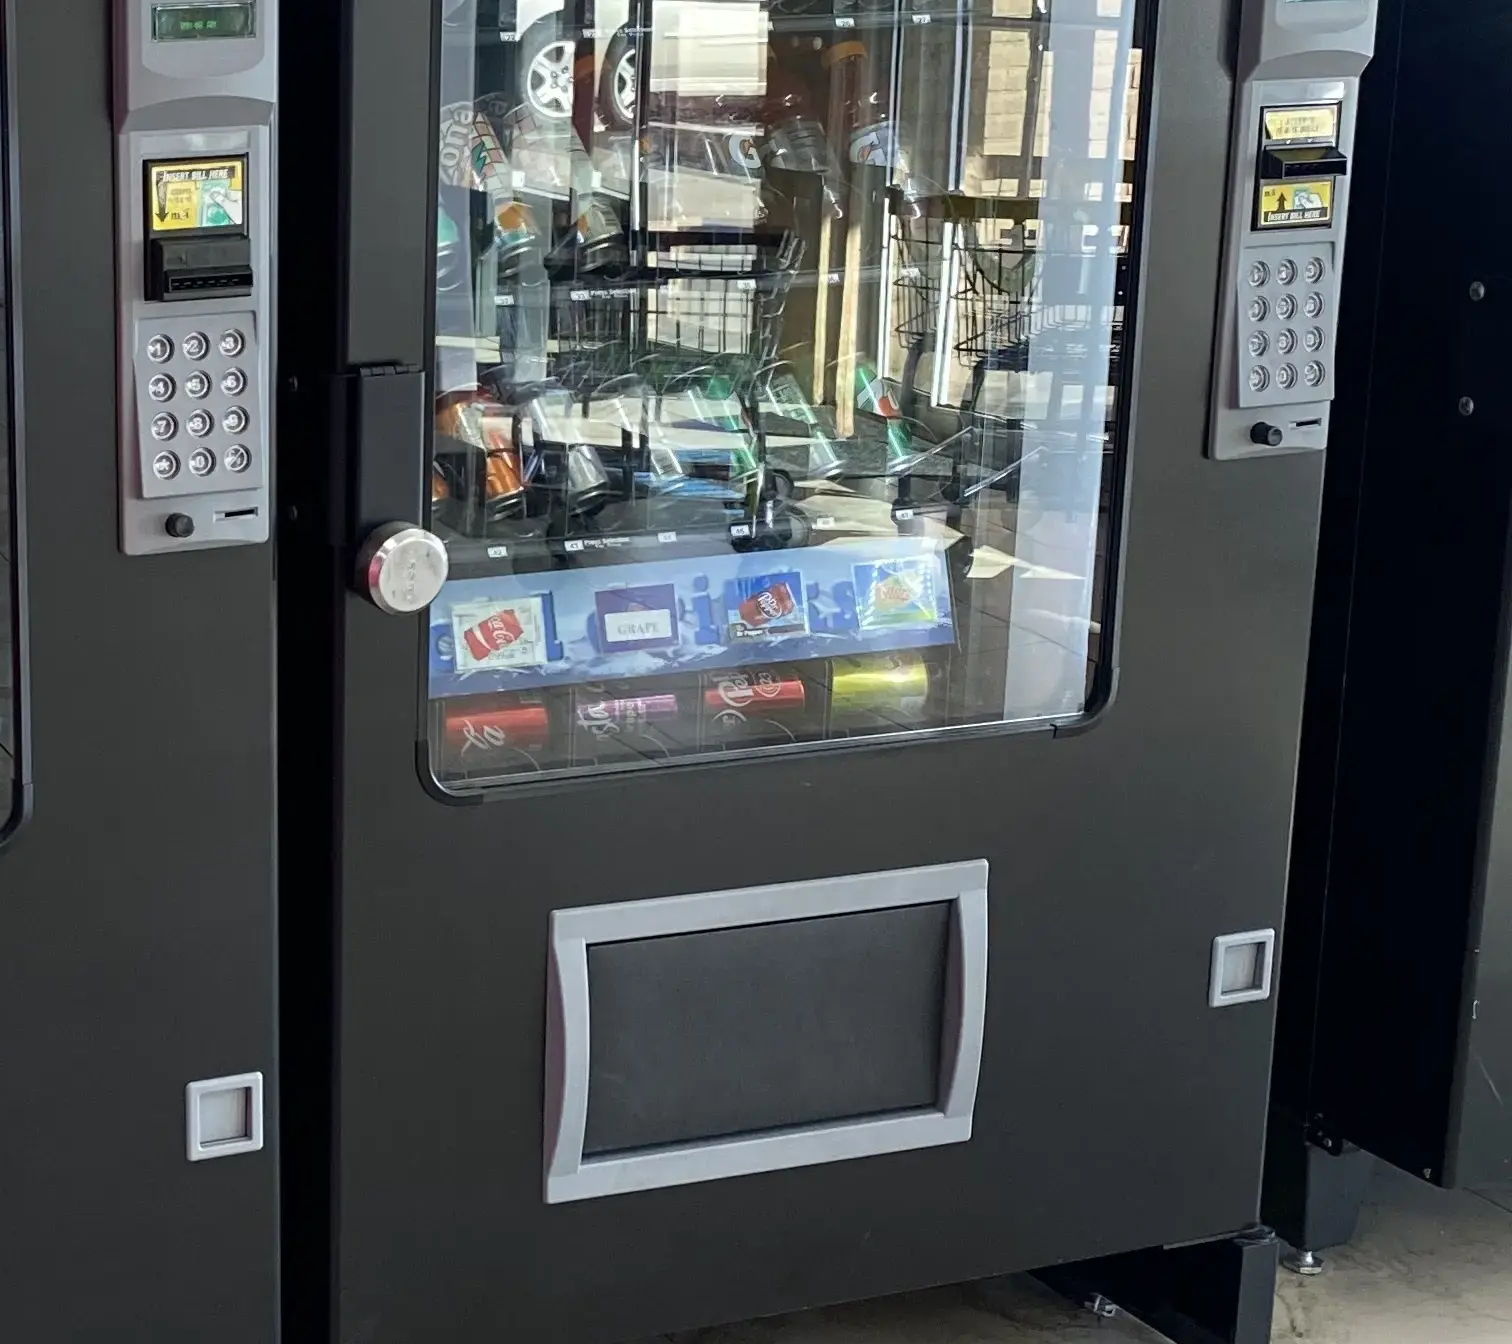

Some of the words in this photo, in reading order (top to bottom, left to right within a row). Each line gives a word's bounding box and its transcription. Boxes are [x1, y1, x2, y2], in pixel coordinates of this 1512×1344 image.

[189, 339, 199, 353] 2
[156, 420, 167, 434] 7
[193, 417, 204, 430] 8
[617, 621, 660, 636] GRAPE
